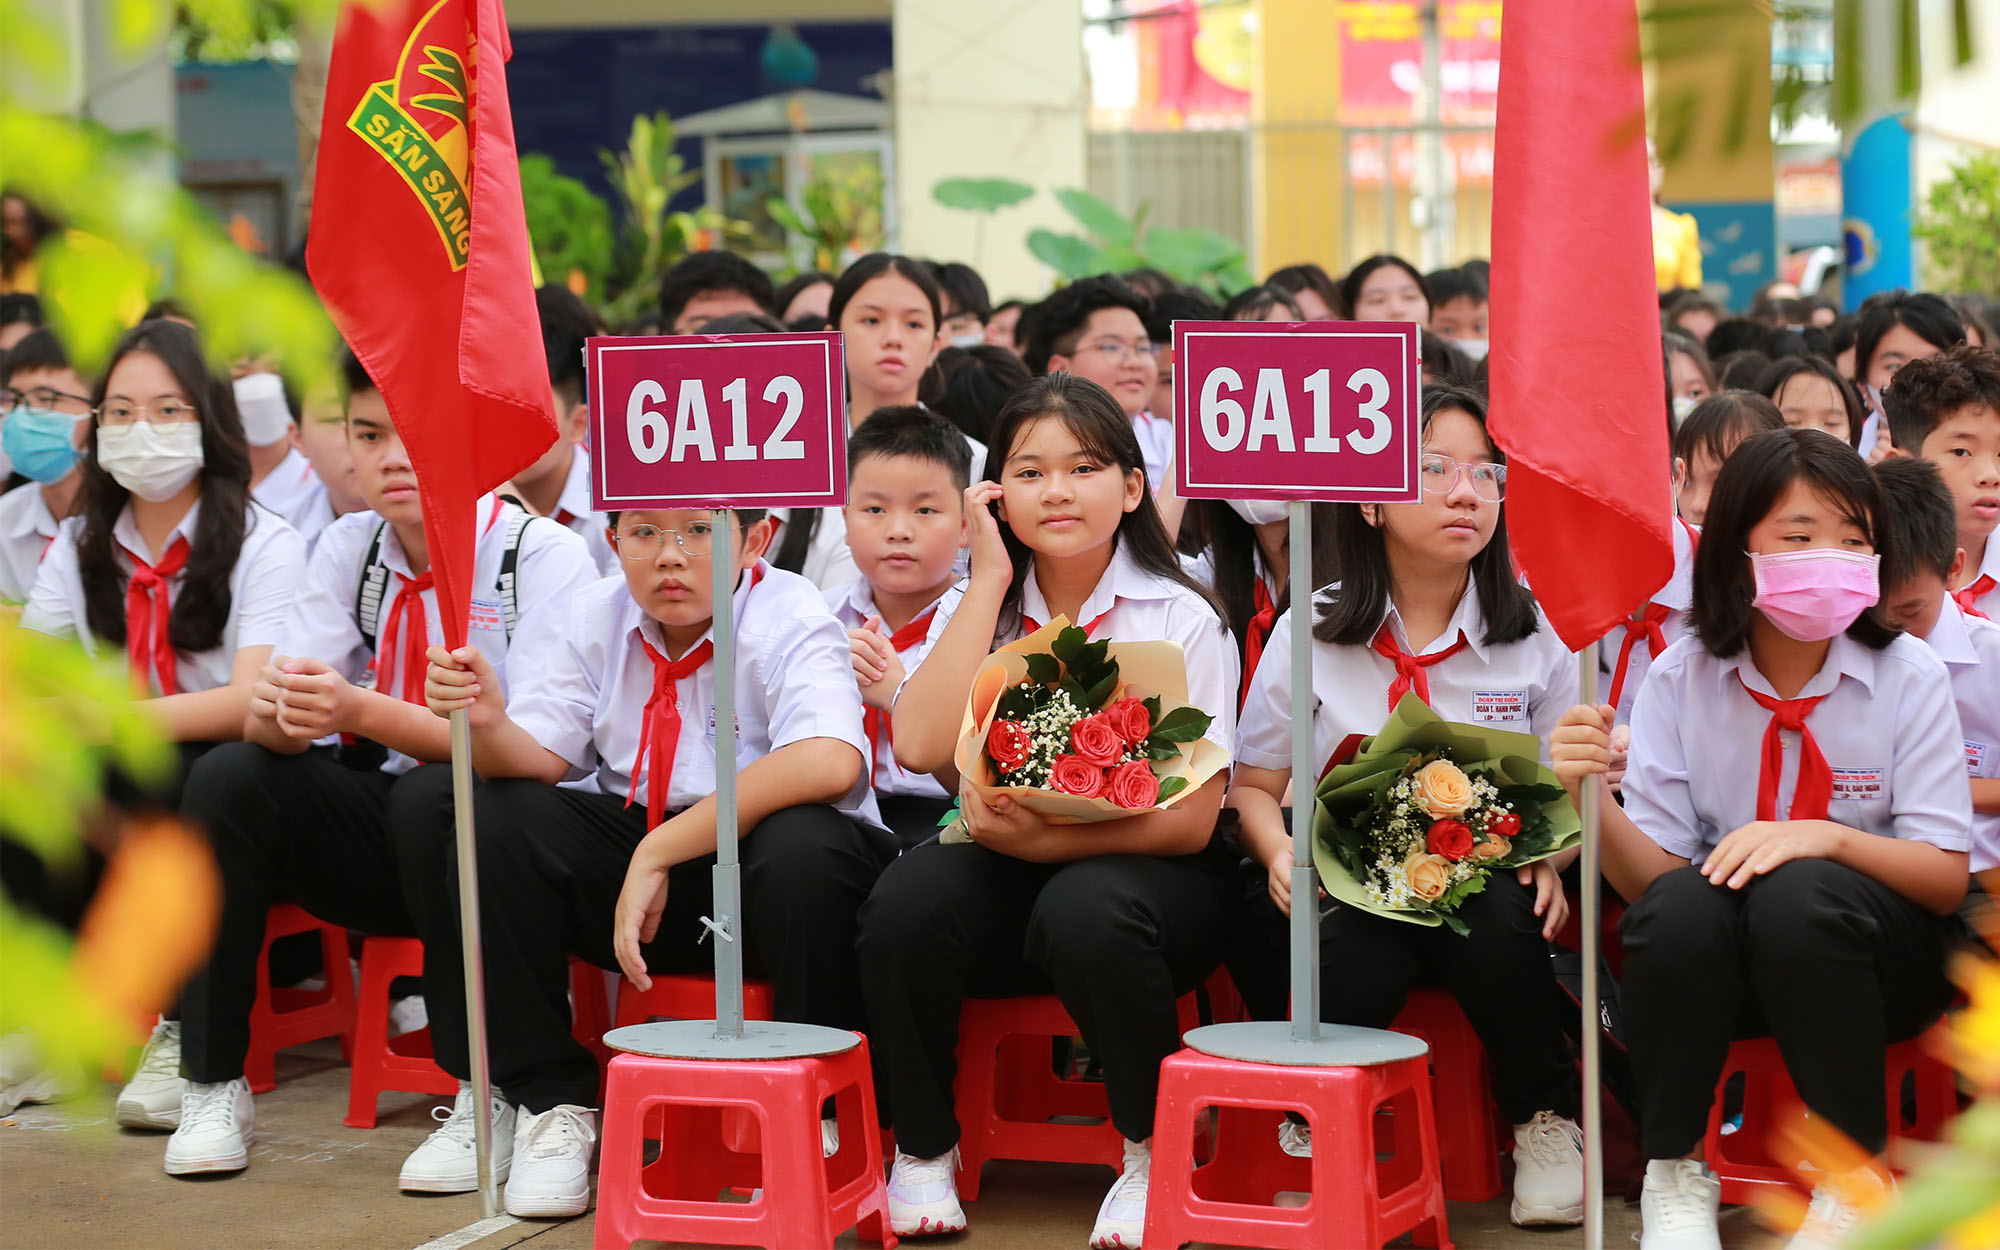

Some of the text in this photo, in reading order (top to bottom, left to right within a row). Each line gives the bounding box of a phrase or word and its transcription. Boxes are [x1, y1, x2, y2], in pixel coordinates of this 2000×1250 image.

[366, 114, 470, 256] SẴN SÀNG
[626, 375, 805, 464] 6A12
[1200, 366, 1392, 455] 6A13
